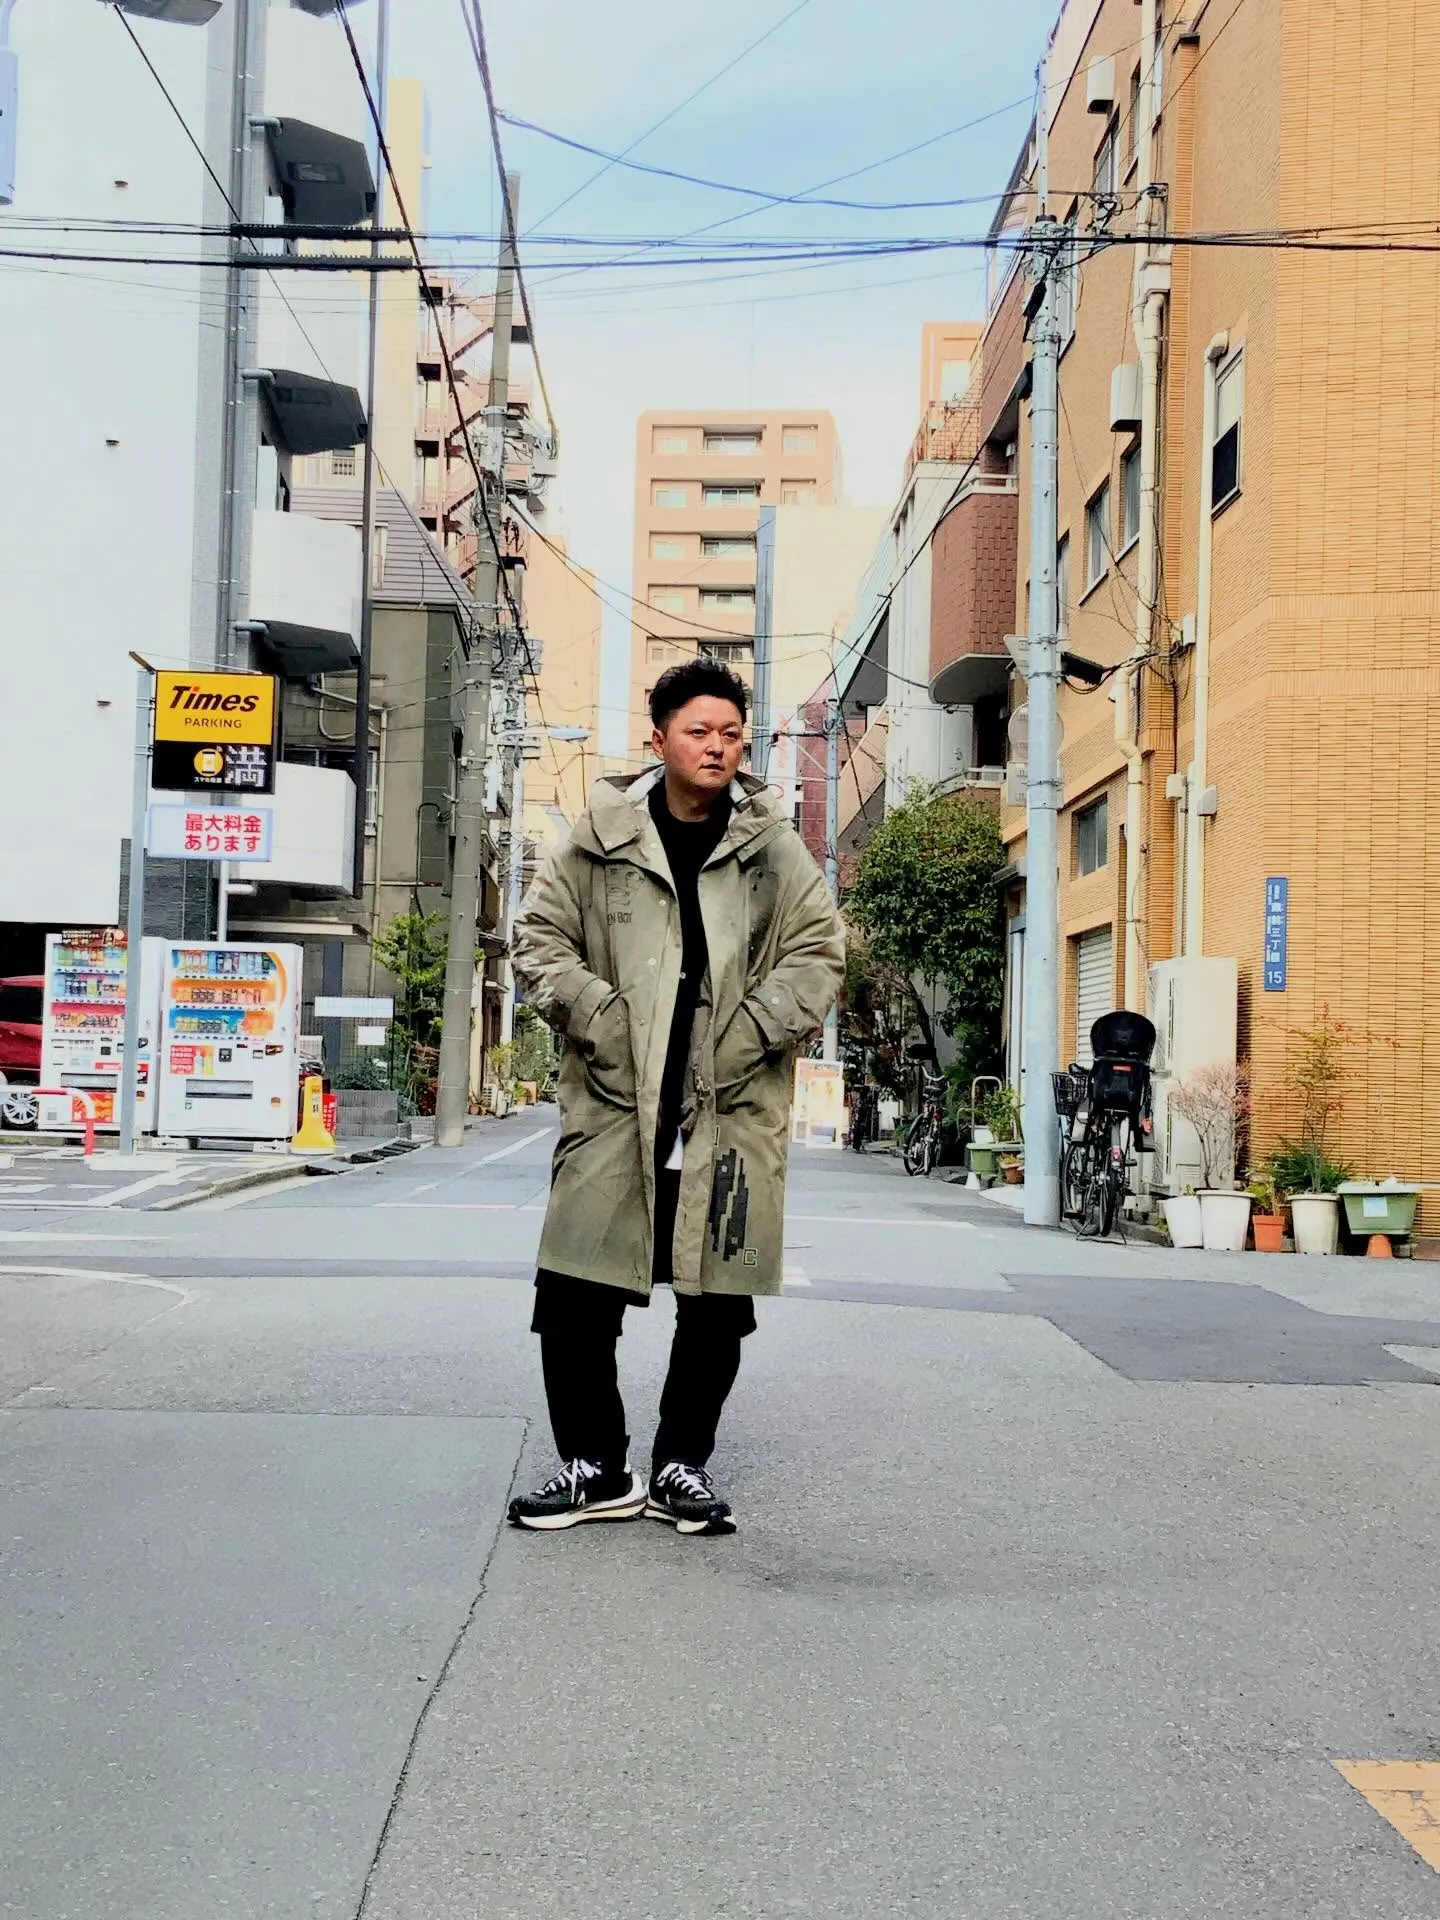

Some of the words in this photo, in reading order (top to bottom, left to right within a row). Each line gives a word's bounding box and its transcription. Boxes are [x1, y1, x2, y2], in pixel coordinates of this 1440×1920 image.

[170, 685, 259, 712] Times
[184, 717, 242, 729] PARKING
[224, 745, 268, 788] 満
[185, 813, 262, 834] 最大料金
[185, 833, 261, 853] あります
[1267, 970, 1283, 984] 15
